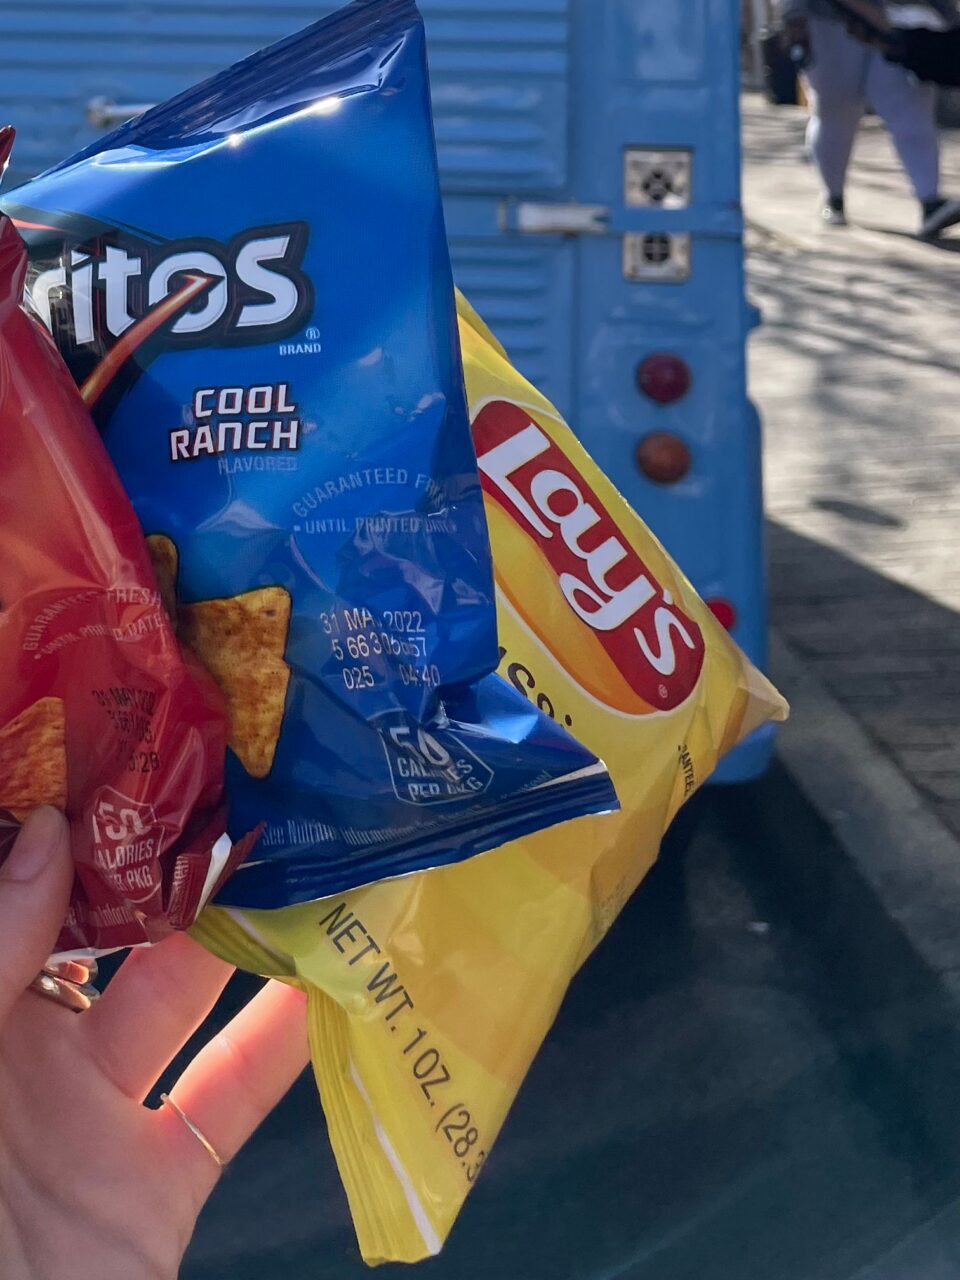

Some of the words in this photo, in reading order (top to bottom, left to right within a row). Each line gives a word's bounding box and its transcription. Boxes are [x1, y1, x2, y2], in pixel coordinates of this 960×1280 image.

[31, 235, 298, 345] ritos
[279, 343, 322, 356] BRAND
[194, 384, 296, 419] COOL
[169, 420, 299, 461] RANCH
[217, 456, 298, 476] FLAVORED
[292, 468, 408, 518] GUARANTEED
[305, 517, 350, 534] UNTIL
[477, 422, 695, 676] Lay's
[320, 613, 340, 635] 31
[344, 607, 381, 631] MA
[383, 610, 426, 633] 2022
[96, 839, 154, 870] ALORIES
[127, 865, 153, 890] PKG
[319, 901, 382, 967] NET
[365, 961, 416, 1032] WT.
[402, 1028, 426, 1055] 1
[412, 1048, 452, 1107] OZ.
